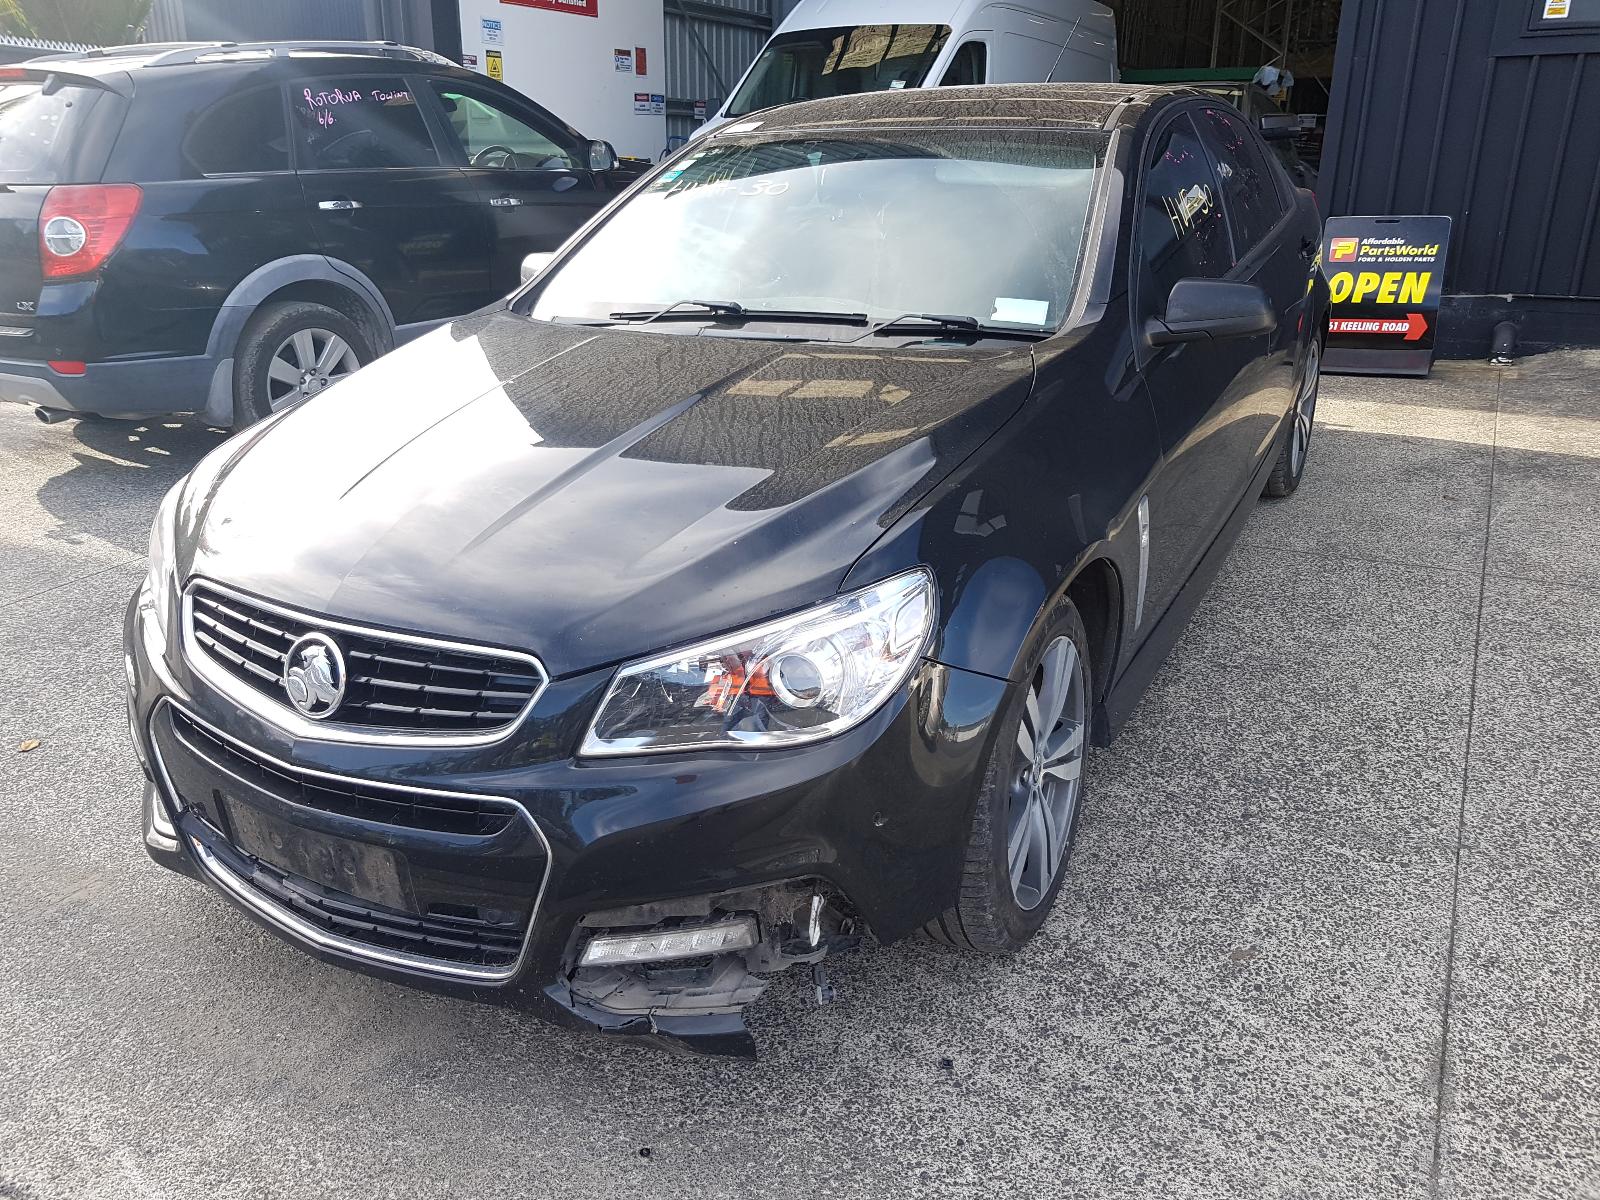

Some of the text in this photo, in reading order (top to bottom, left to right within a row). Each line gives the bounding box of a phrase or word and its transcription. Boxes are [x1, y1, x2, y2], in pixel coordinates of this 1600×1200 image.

[1360, 237, 1405, 245] Affordable
[1359, 244, 1439, 256] PartsWorld
[1329, 271, 1432, 304] OPEN
[1340, 321, 1379, 331] KEELING
[1381, 322, 1410, 332] ROAD
